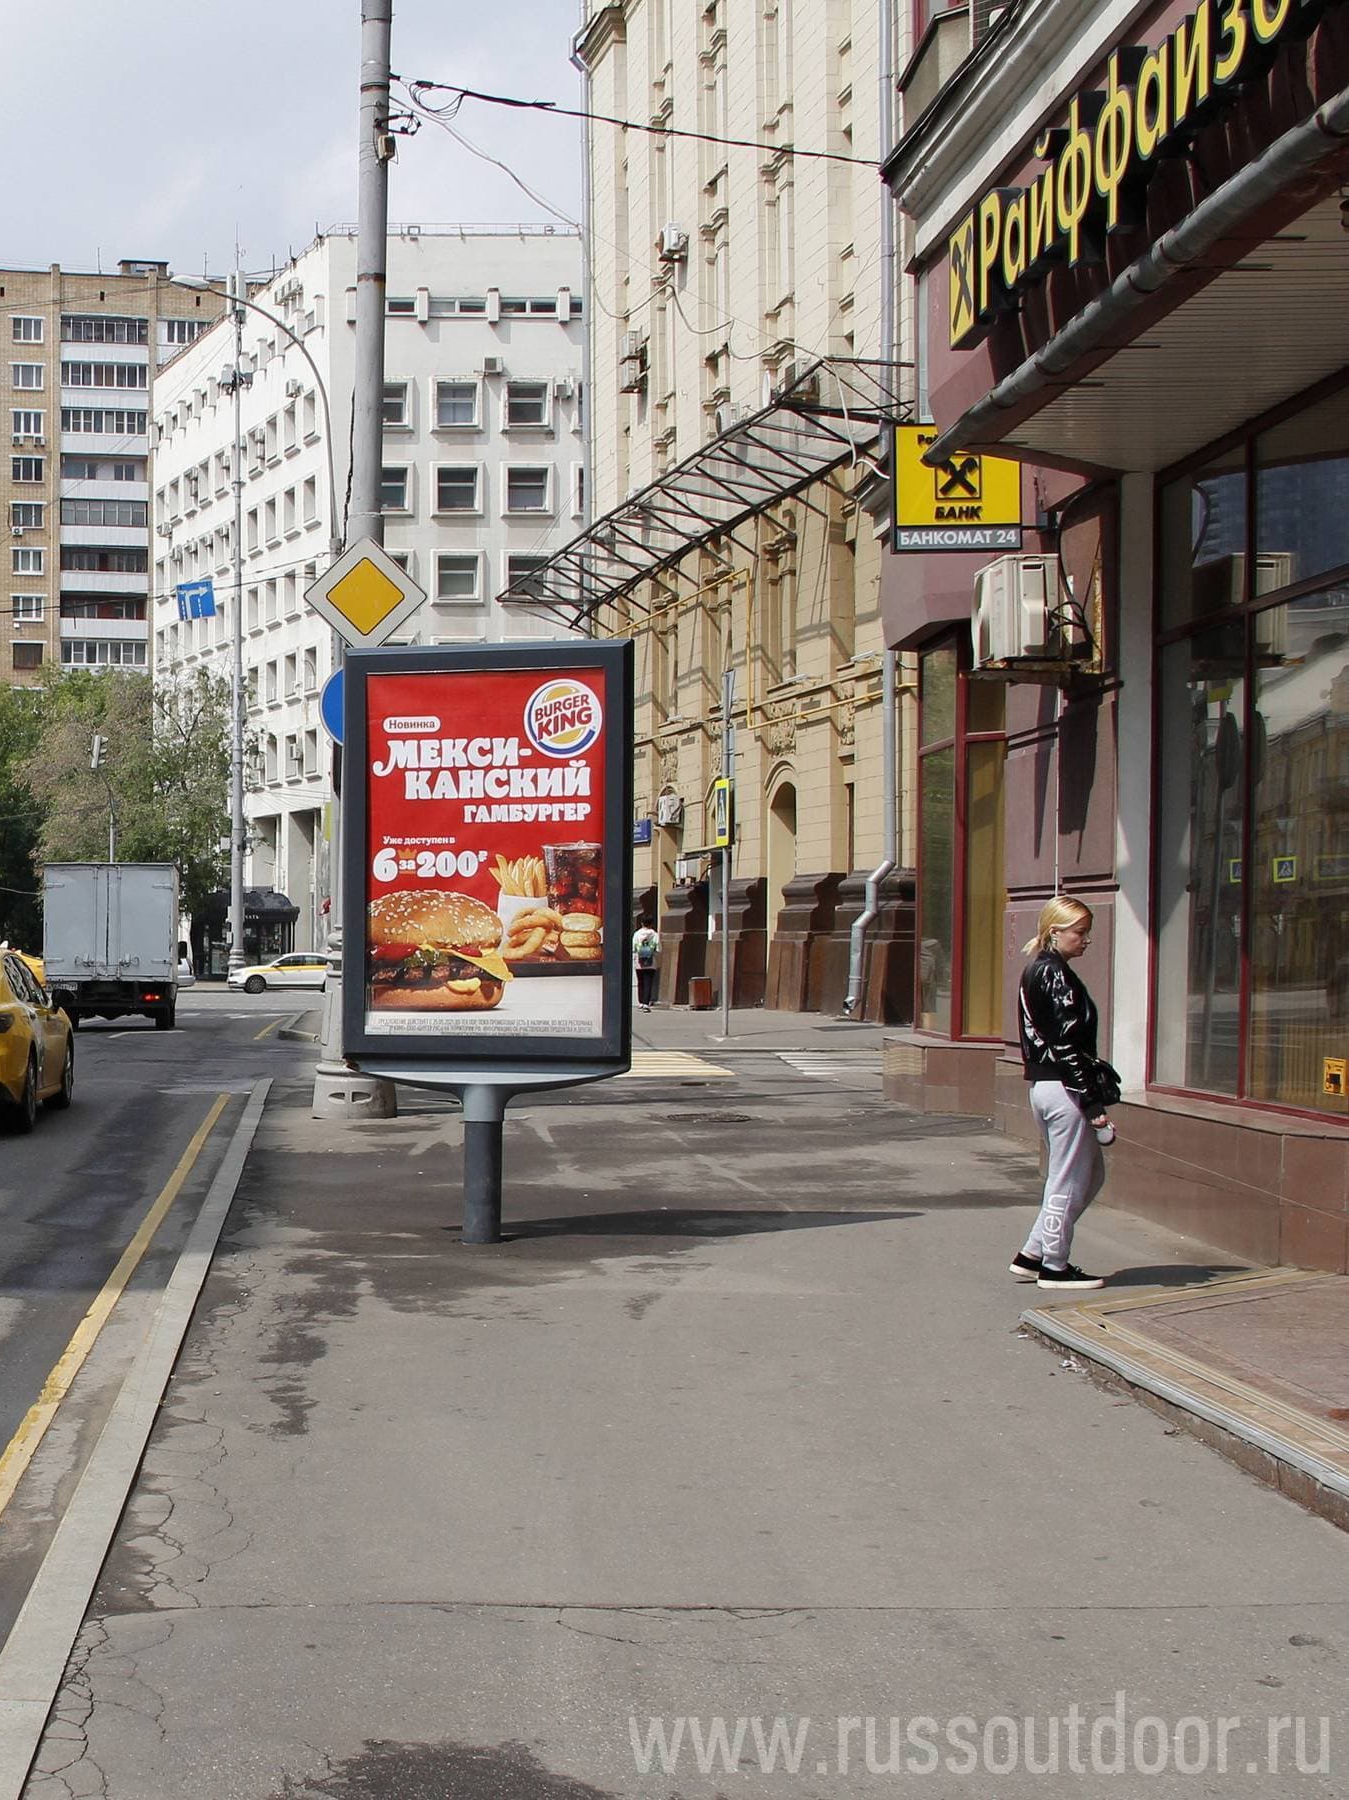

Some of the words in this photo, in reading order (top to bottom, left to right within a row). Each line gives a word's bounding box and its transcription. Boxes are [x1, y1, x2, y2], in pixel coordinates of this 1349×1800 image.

[935, 506, 982, 520] БАНК
[900, 530, 992, 546] БАНКОМАТ
[996, 530, 1017, 544] 24
[534, 693, 590, 722] BURGER
[388, 719, 436, 730] Новинка
[537, 706, 593, 742] KING
[372, 737, 533, 777] МЕКСИ-
[404, 759, 591, 800] КАНСКИЙ
[463, 803, 591, 823] ГАМБУРГЕР
[382, 836, 403, 845] Уже
[404, 837, 449, 846] доступен
[373, 847, 398, 882] 6
[398, 860, 416, 870] за
